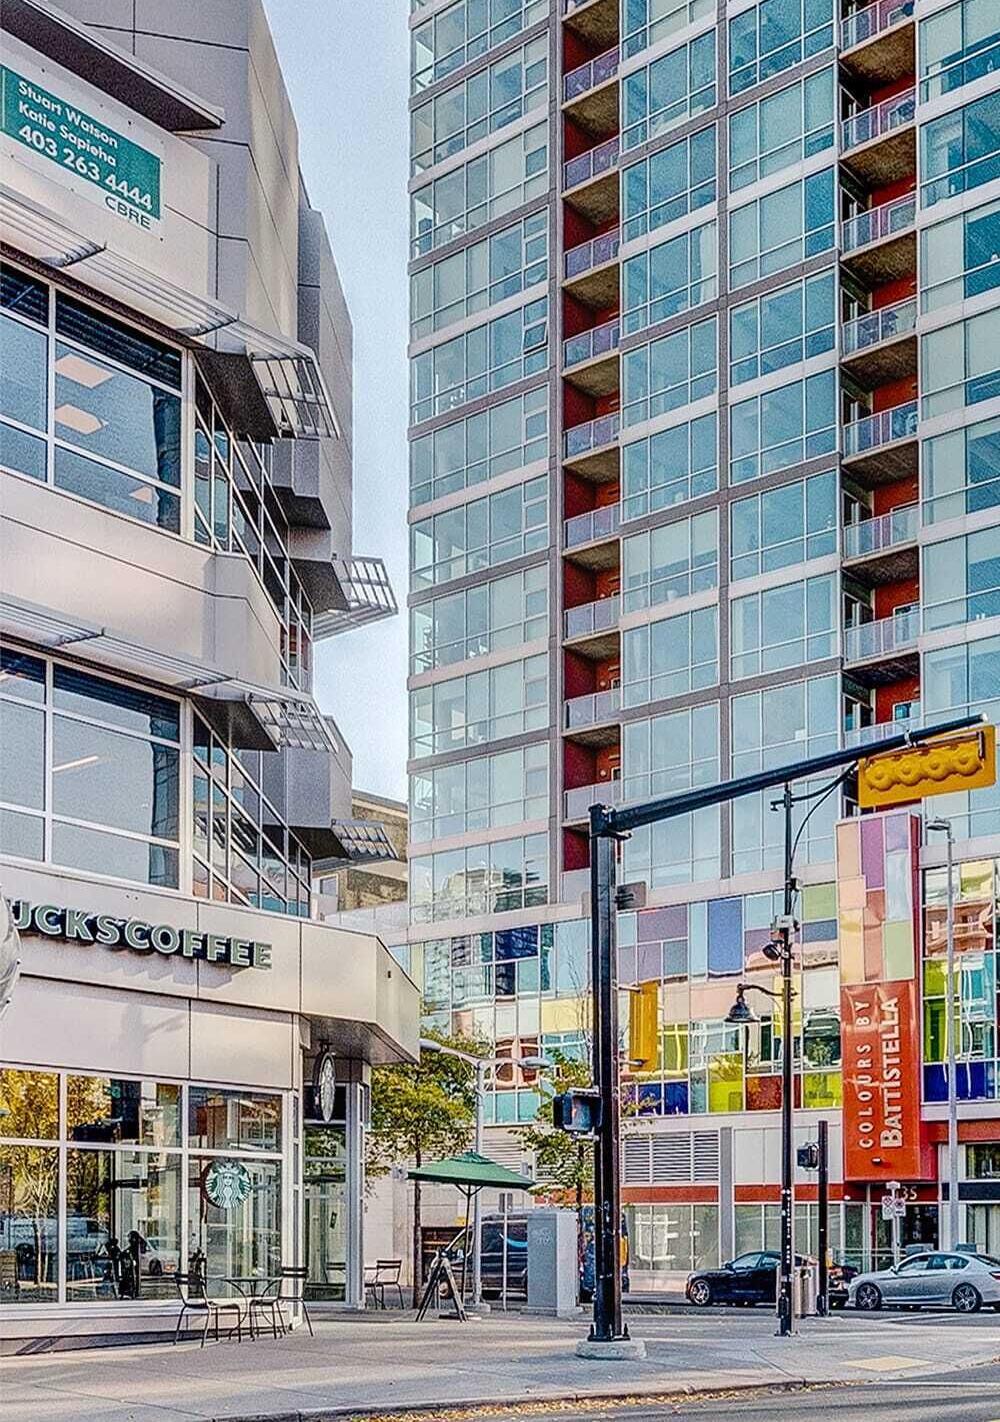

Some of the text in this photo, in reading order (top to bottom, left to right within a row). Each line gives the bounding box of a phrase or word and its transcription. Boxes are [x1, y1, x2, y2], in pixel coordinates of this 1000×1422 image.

[18, 80, 118, 149] Stuart Watson
[18, 101, 56, 131] Katie
[18, 125, 153, 211] 403 263 4444
[104, 196, 151, 229] CBRE
[855, 1001, 874, 1148] COLOURS BY
[880, 997, 903, 1148] BATTISTELLA
